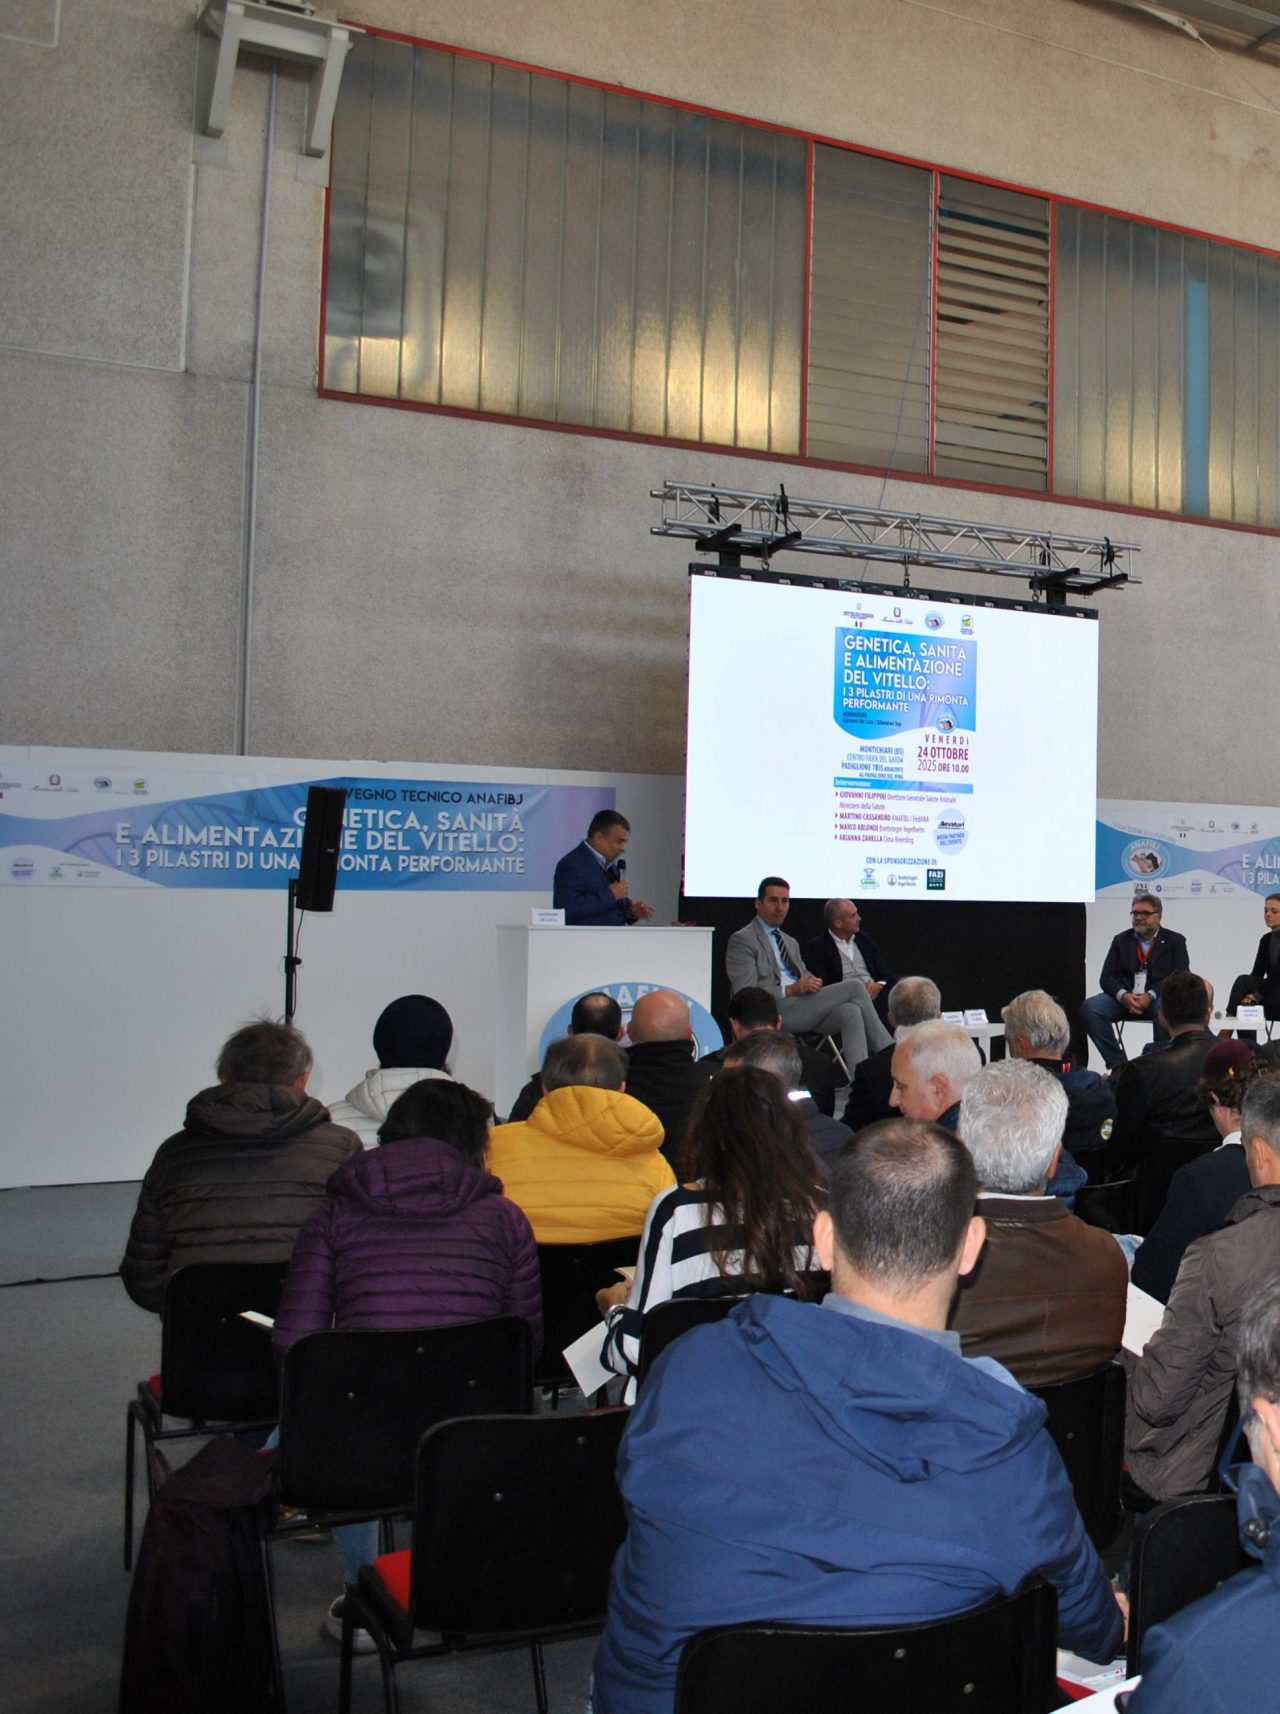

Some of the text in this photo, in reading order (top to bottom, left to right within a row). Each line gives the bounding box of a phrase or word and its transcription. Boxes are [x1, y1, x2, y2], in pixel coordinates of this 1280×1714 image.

[843, 635, 967, 660] GENETICA, SANITÀ
[844, 652, 963, 677] E ALIMENTAZIONE
[844, 670, 931, 690] DEL VITELLO:
[843, 687, 969, 706] I 3 PILASTRI DI UNA RIMONTA
[843, 699, 910, 713] PERFORMANTE
[917, 746, 969, 761] 24 OTTOBRE
[917, 758, 970, 774] 2025 ORE 10.00
[346, 788, 524, 806] VEGNO TECNICO ANAFIBJ
[839, 791, 864, 799] GIOVANNI
[864, 792, 887, 800] FILIPPINI
[293, 806, 526, 833] GETICA, SANITÀ
[863, 813, 891, 821] CASSANDRO
[839, 823, 857, 831] MARCO
[116, 823, 526, 854] E ALIMENTAZIE DEL VITELLO:
[116, 848, 526, 875] I 3 PILASTRI DI UNA ONTA PERFORMANTE
[1242, 854, 1250, 869] E
[1248, 872, 1255, 885] 3
